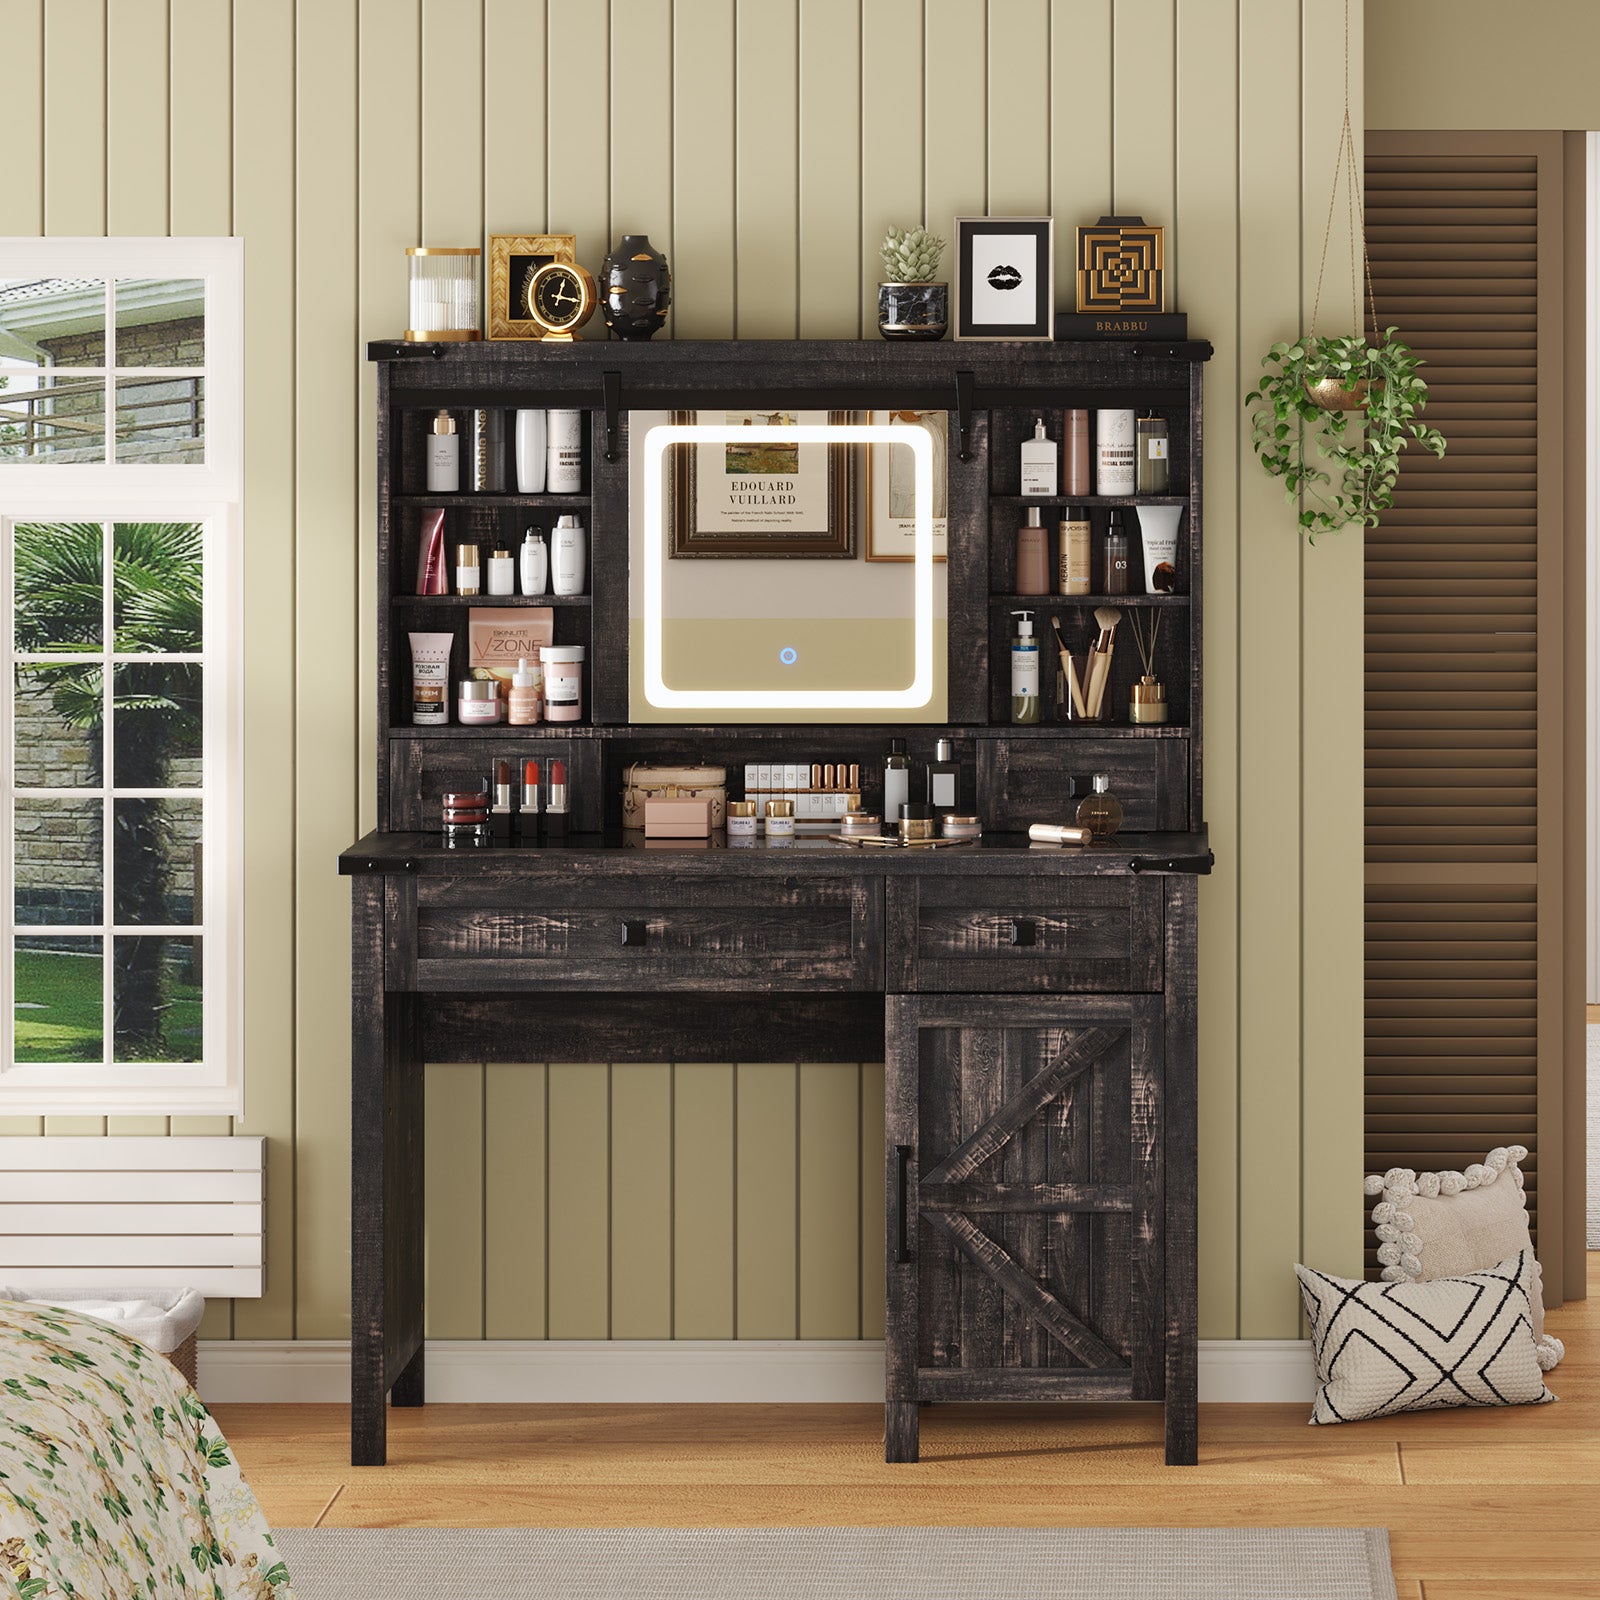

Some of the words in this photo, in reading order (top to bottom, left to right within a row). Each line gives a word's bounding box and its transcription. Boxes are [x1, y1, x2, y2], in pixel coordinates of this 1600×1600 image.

[1096, 321, 1148, 331] BRABBU
[731, 481, 794, 491] EDOUARD
[729, 495, 796, 505] VUILLARD
[1060, 553, 1068, 583] KERATIN
[1115, 560, 1127, 570] 03
